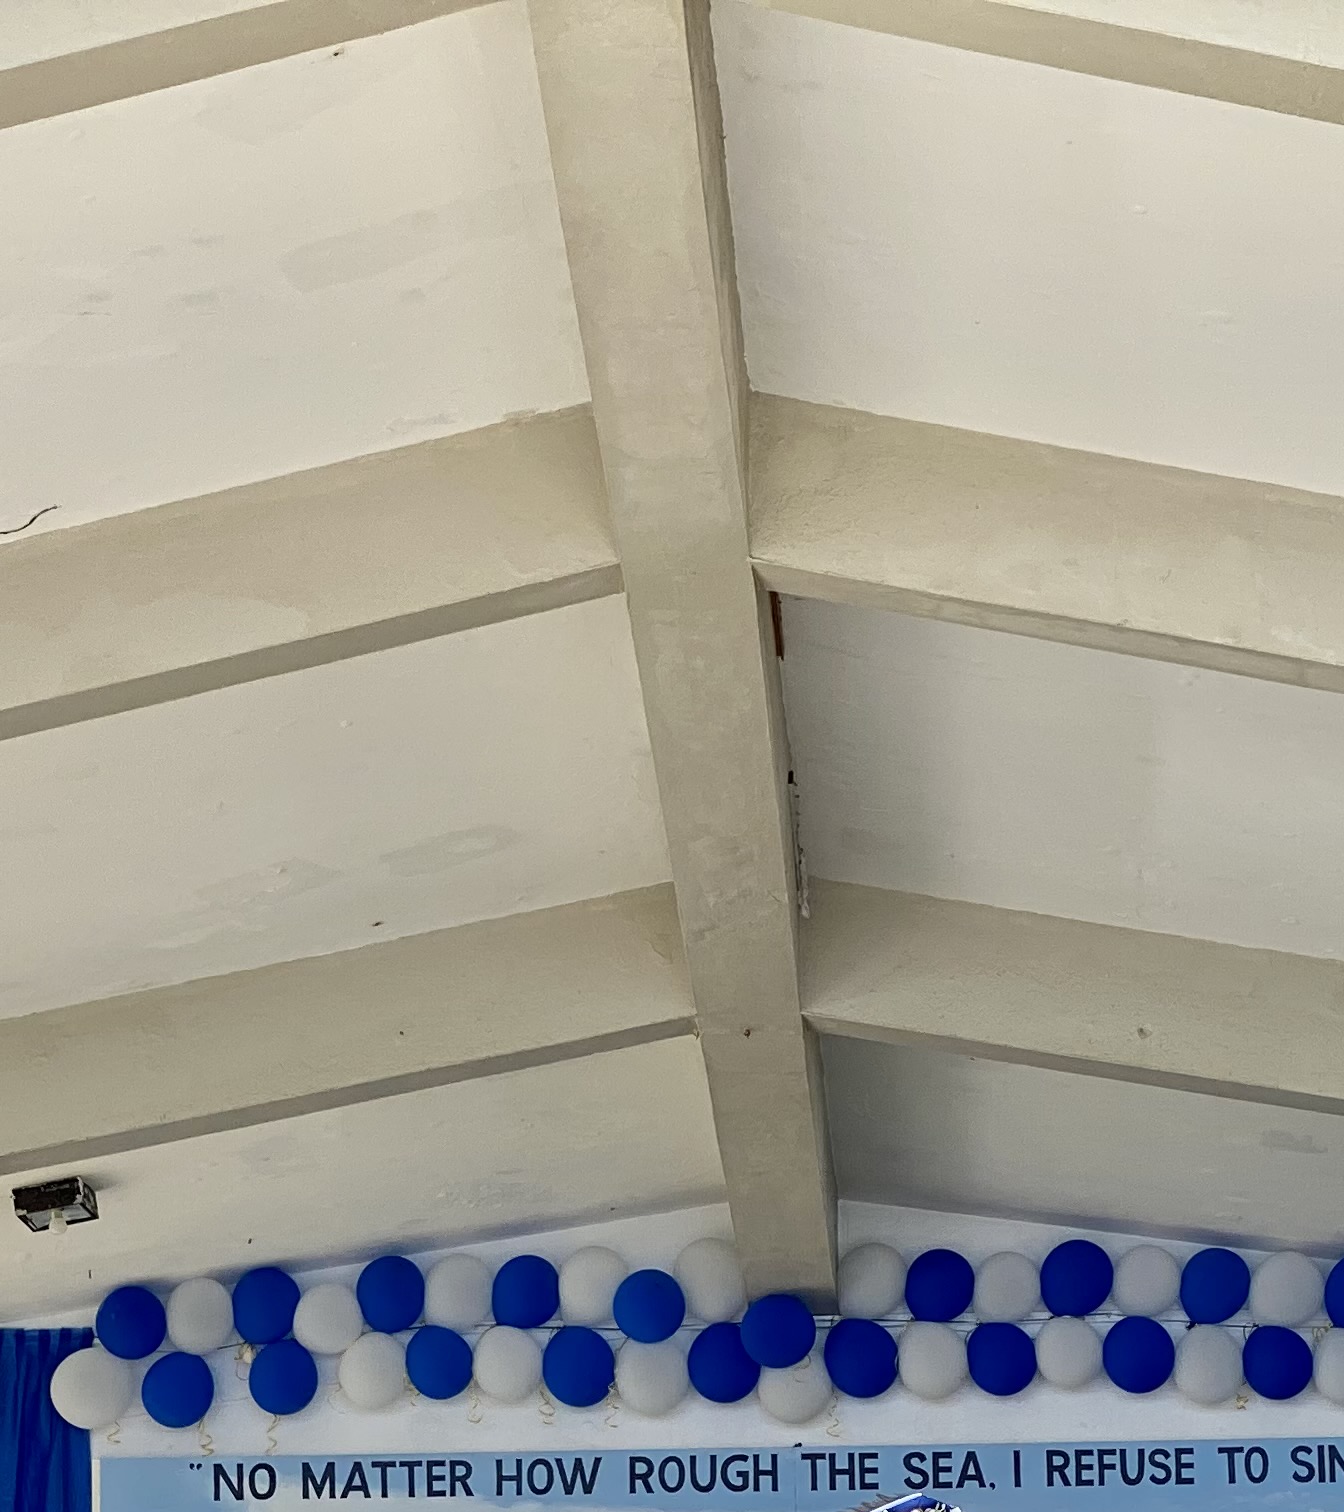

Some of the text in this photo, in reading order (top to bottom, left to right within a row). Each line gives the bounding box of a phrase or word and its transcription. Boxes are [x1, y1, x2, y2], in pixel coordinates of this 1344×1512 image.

[301, 1459, 475, 1500] MATTER
[495, 1457, 603, 1497] HOW
[628, 1453, 779, 1495] ROUGH
[800, 1452, 880, 1492] THE
[902, 1451, 996, 1491] SEA,
[1012, 1449, 1022, 1489] I
[1045, 1447, 1195, 1488] REFUSE
[1217, 1446, 1270, 1485] TO
